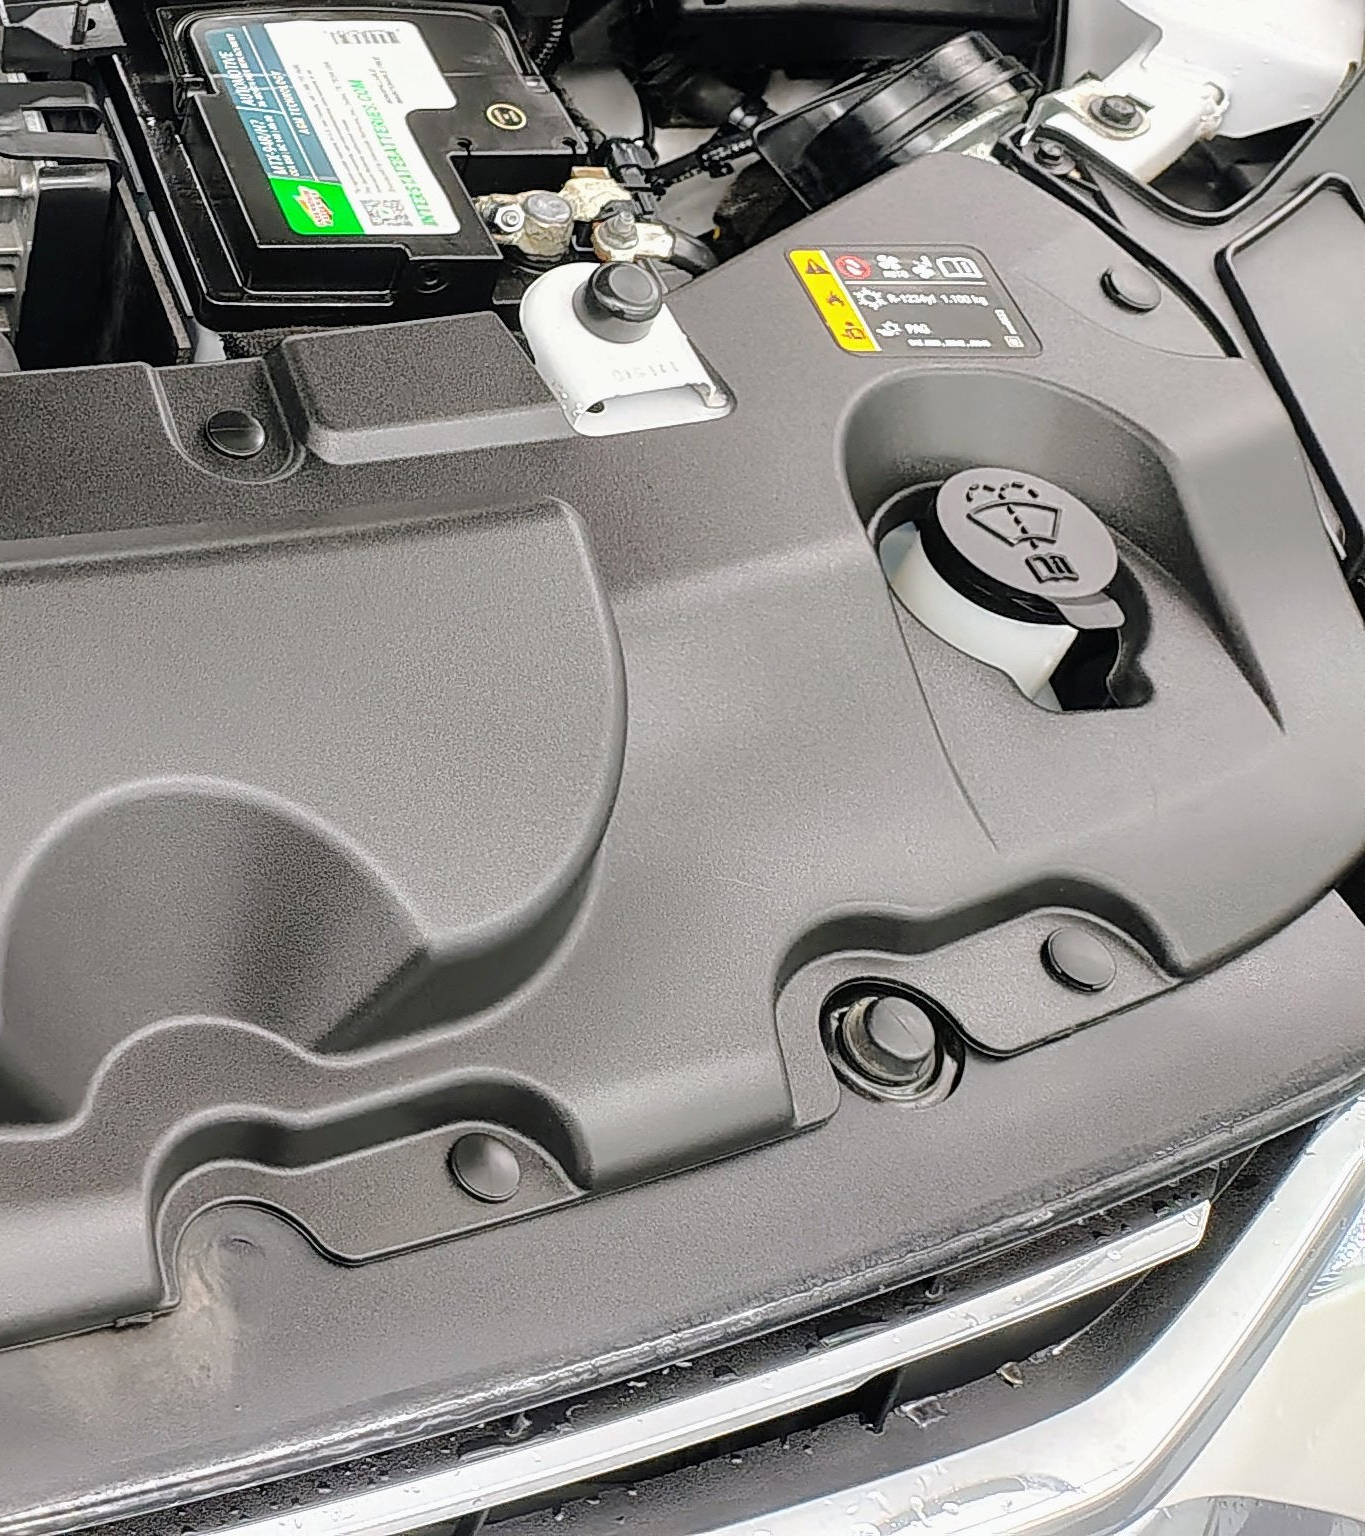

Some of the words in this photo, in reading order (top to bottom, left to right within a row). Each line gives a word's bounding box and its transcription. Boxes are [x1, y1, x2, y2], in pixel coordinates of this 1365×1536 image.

[218, 50, 257, 107] AUTOMOTIVE
[270, 70, 303, 116] TECHNOLOGY
[292, 116, 311, 135] AGM
[347, 78, 439, 227] INTERSTATEBATTERIES.COM
